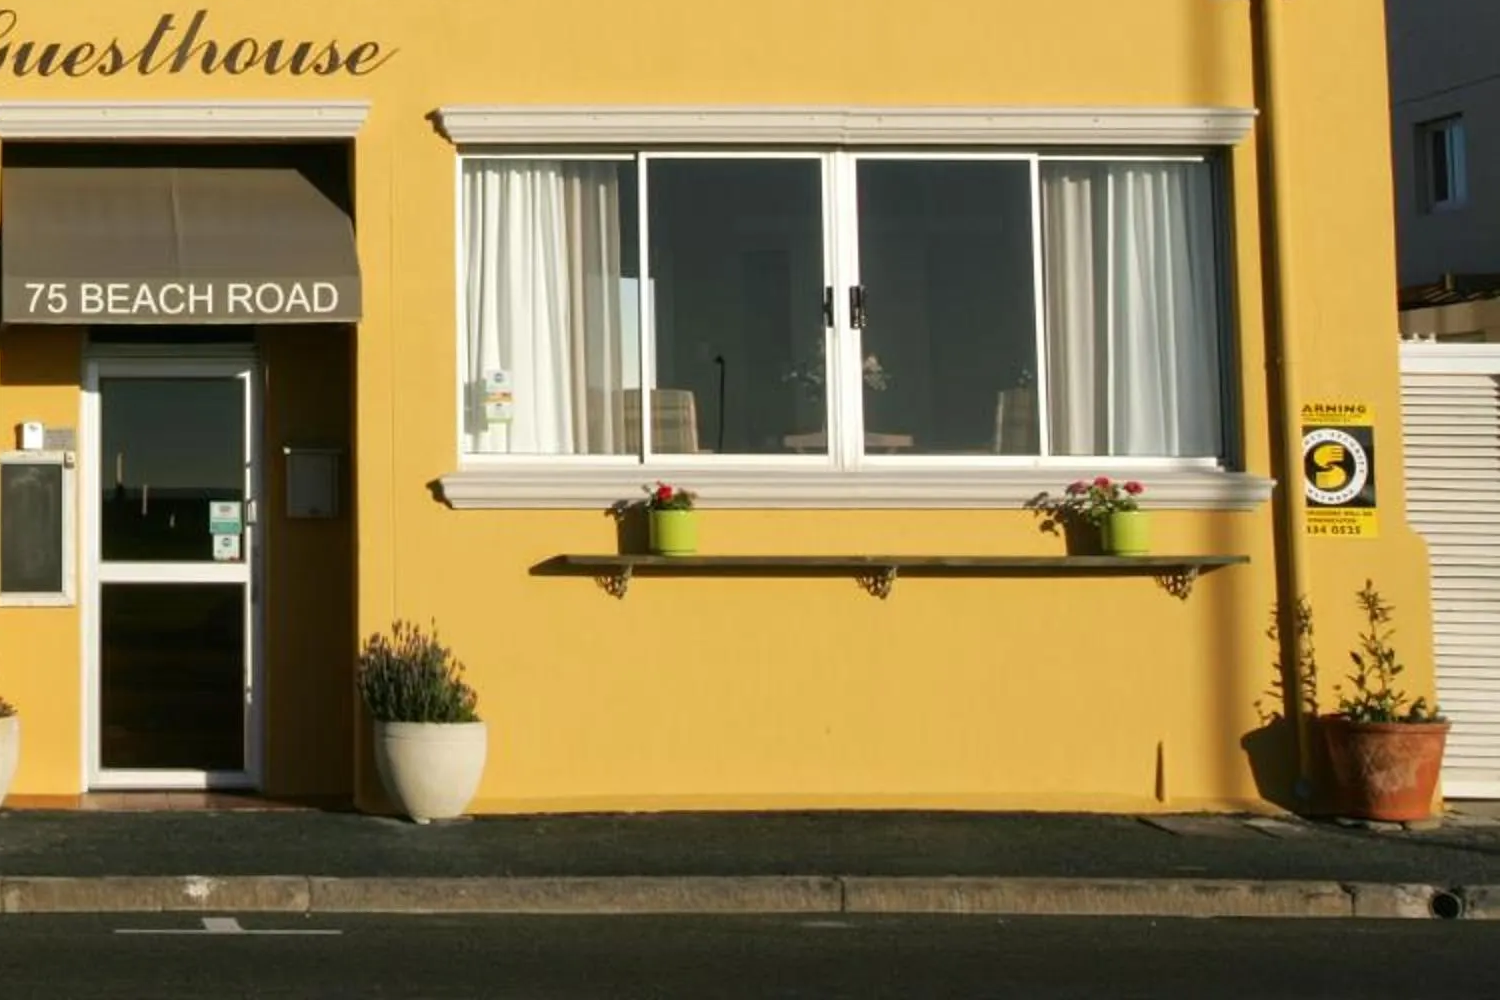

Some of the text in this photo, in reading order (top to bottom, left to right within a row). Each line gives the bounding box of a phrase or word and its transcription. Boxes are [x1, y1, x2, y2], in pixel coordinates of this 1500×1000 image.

[24, 281, 339, 315] 75 BEACH ROAD
[1301, 403, 1367, 414] ARNING
